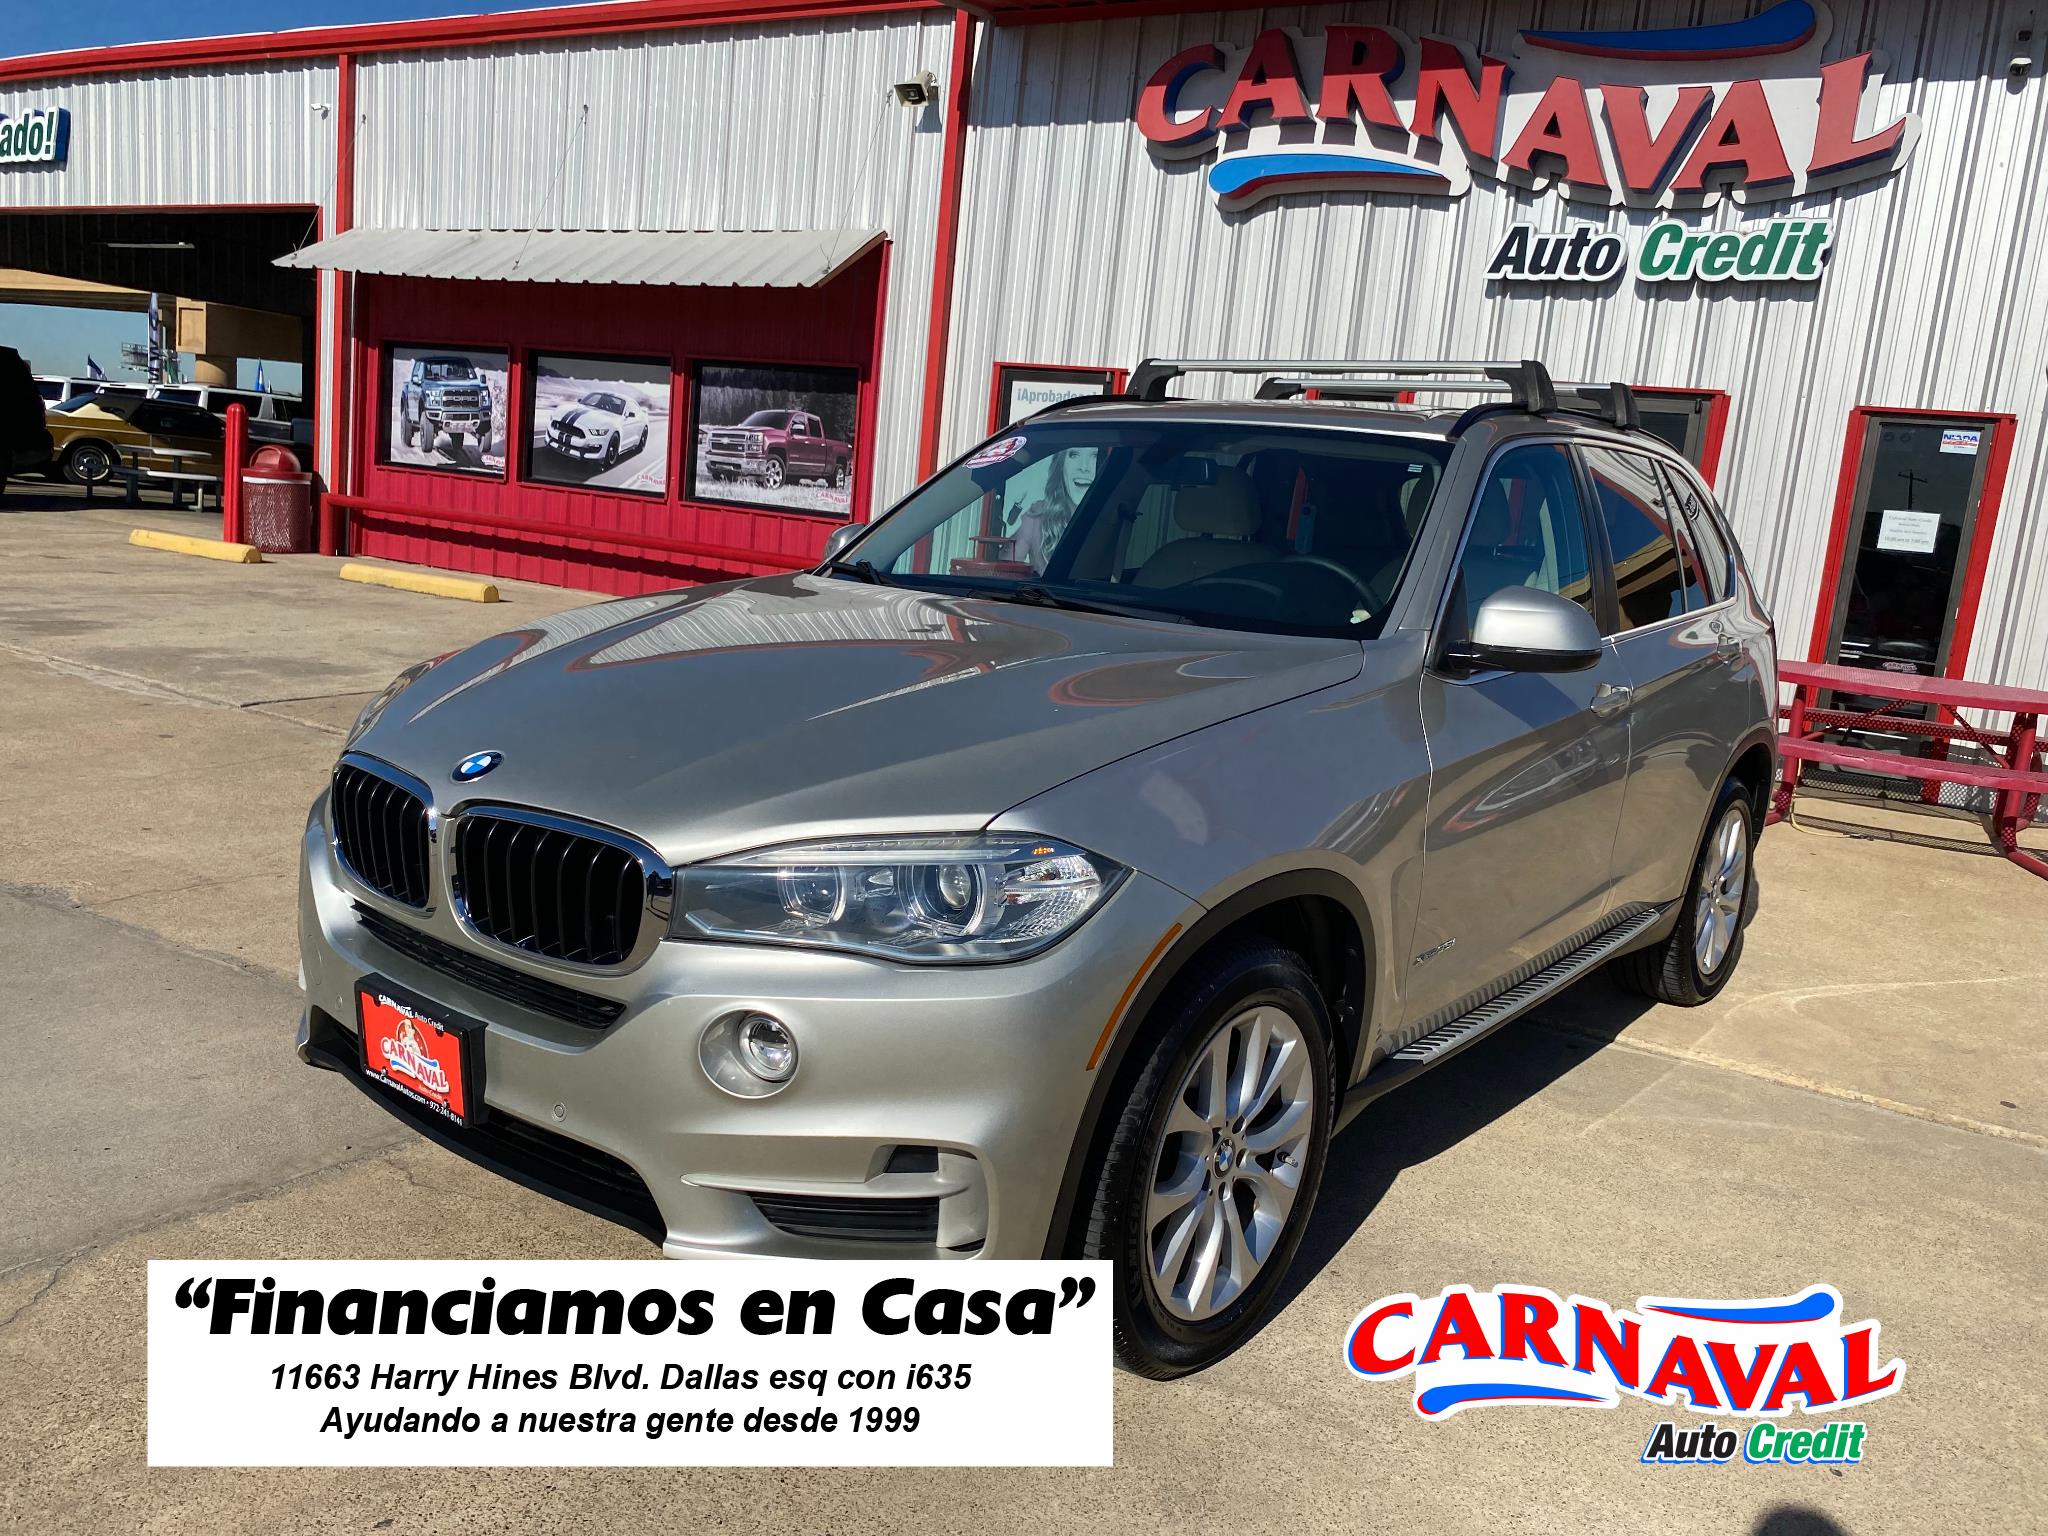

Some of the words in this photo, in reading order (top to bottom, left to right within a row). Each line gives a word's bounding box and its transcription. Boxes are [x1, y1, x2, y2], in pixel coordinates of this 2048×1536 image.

[1137, 25, 1907, 194] CARNAVAL
[1487, 225, 1621, 277] Auto
[1638, 220, 1831, 277] Credit
[382, 1039, 449, 1089] CARNAVAL
